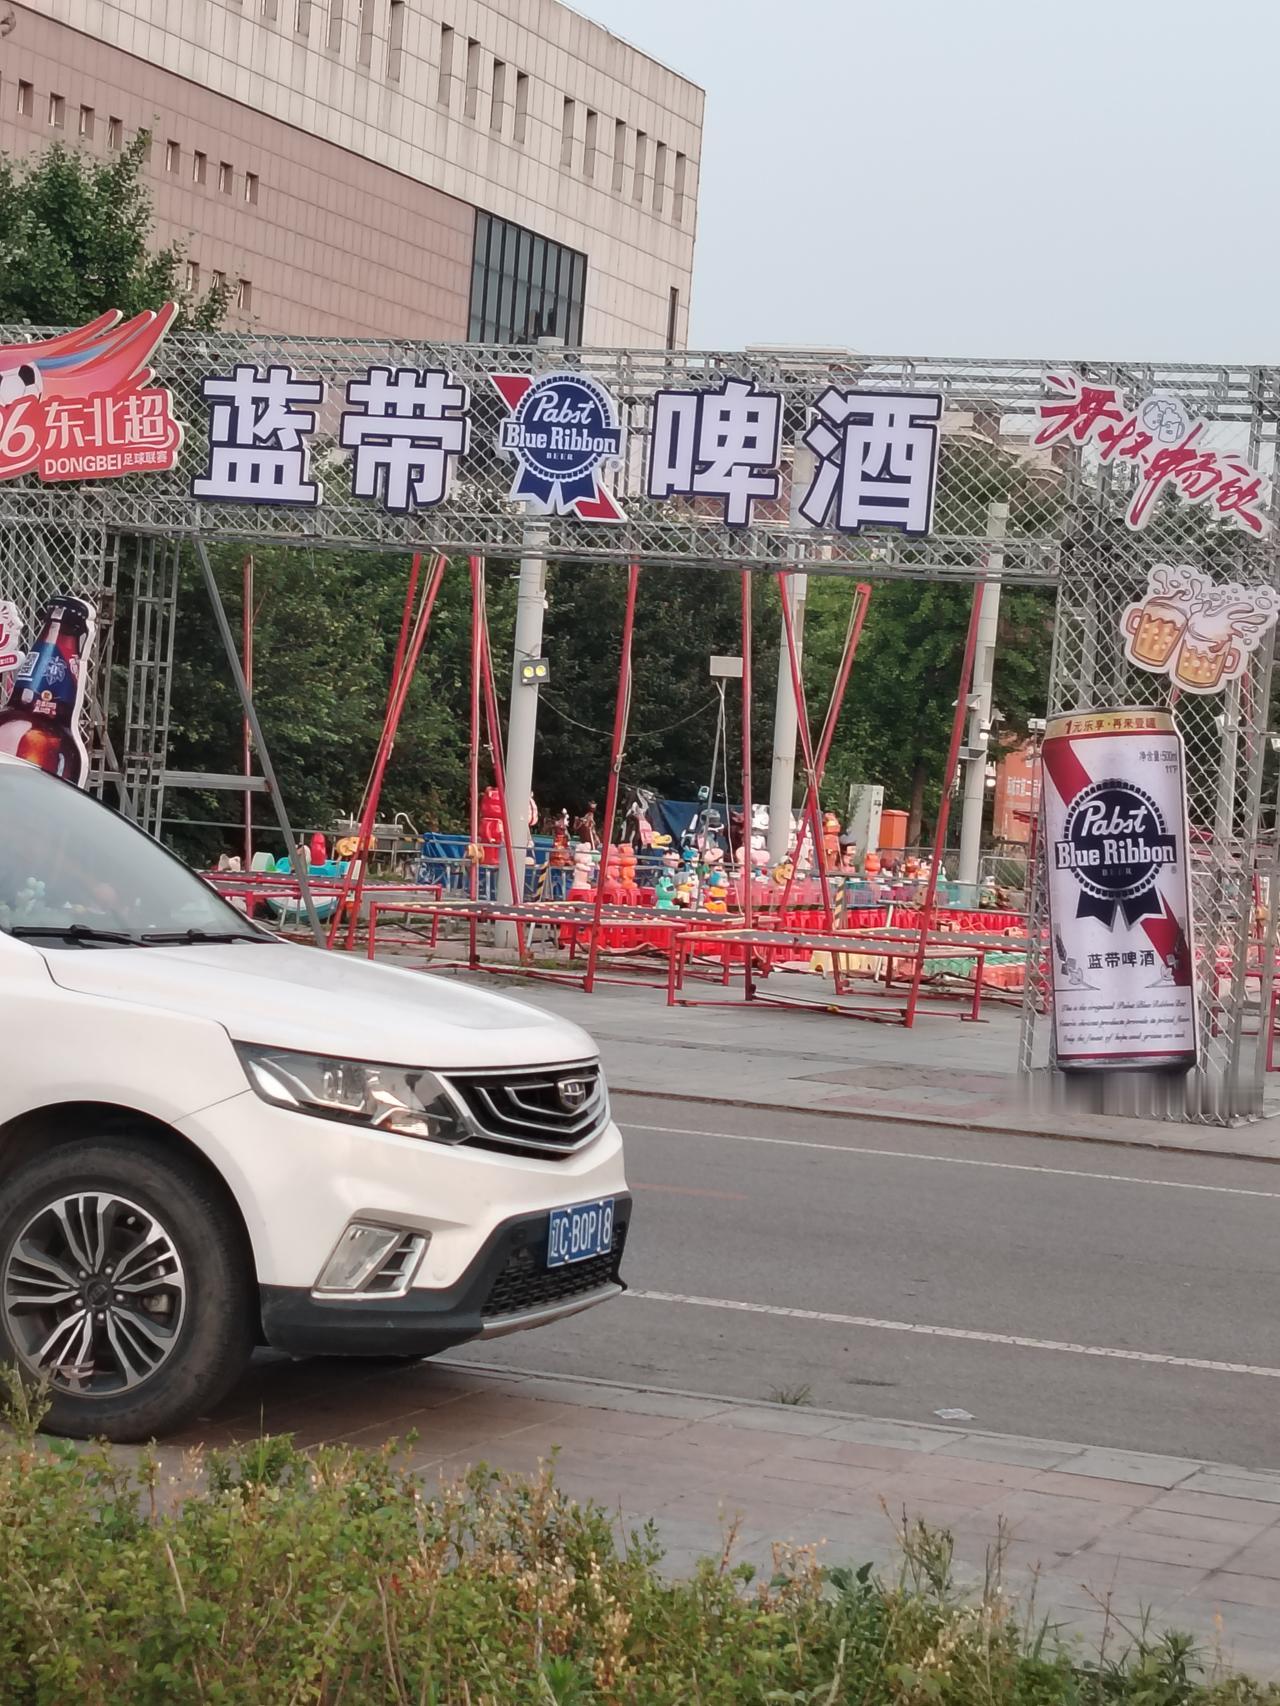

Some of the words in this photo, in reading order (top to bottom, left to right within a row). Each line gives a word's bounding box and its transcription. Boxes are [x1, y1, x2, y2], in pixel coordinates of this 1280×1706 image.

[44, 395, 166, 450] 东北超
[534, 390, 595, 424] Pabst
[192, 365, 468, 512] 蓝带
[649, 378, 942, 534] 啤酒
[505, 423, 548, 449] Blue
[550, 426, 617, 454] Ribbon
[45, 453, 122, 475] DONGBEI
[546, 452, 573, 461] BEER
[1079, 800, 1148, 837] Pabst
[1057, 842, 1100, 868] Blue
[1103, 837, 1175, 865] Ribbon
[1088, 950, 1155, 969] 蓝带啤酒
